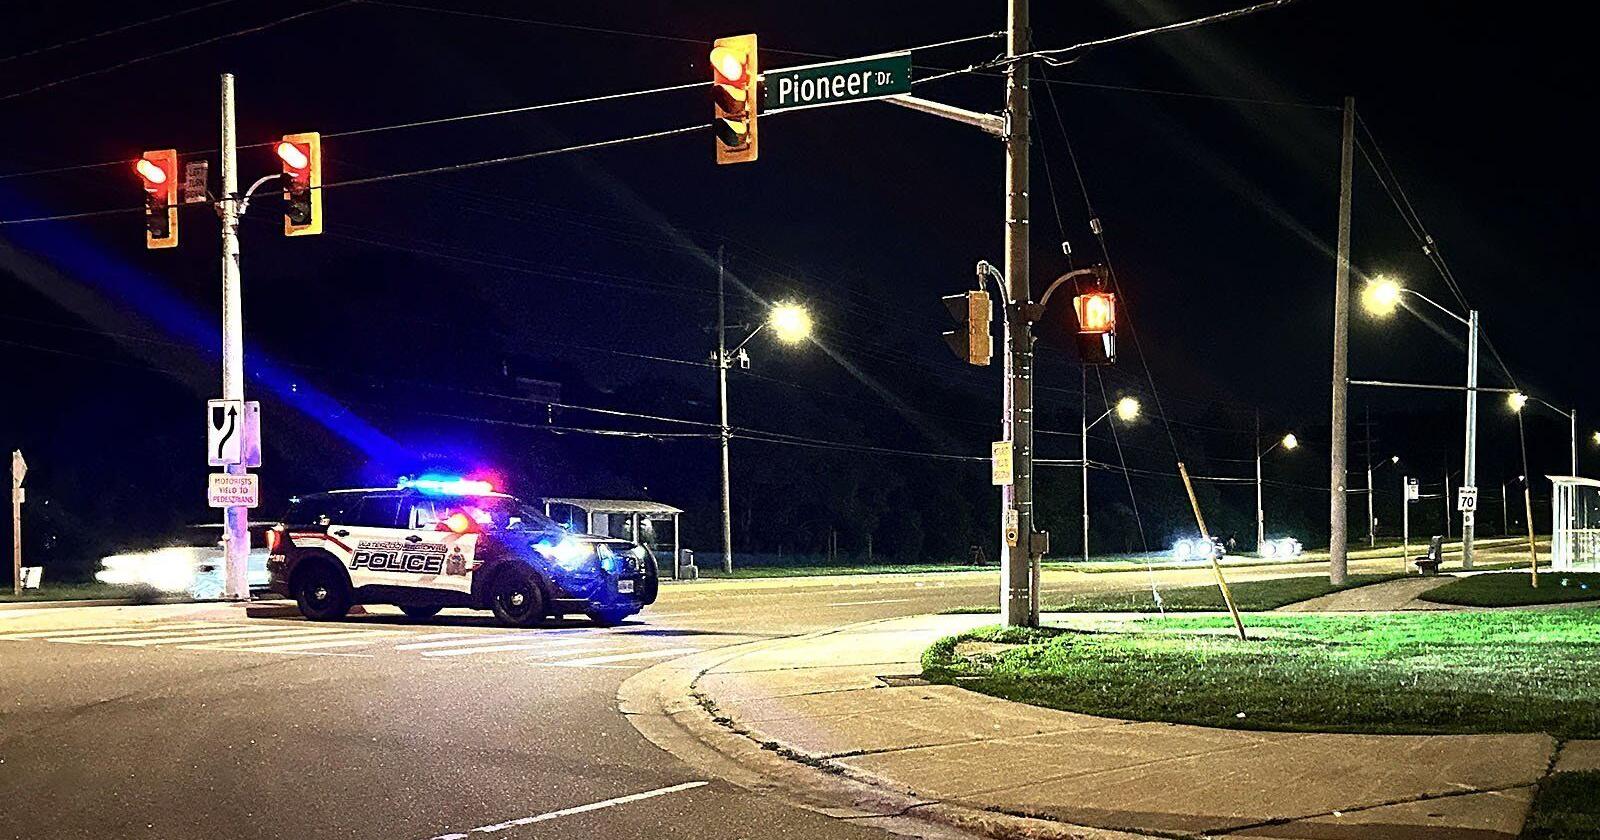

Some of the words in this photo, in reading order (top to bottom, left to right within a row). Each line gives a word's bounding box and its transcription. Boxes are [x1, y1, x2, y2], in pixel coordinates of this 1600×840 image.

[779, 71, 872, 104] Pioneer
[877, 71, 894, 86] Dr.
[1461, 497, 1474, 507] 70
[349, 549, 445, 575] POLICE
